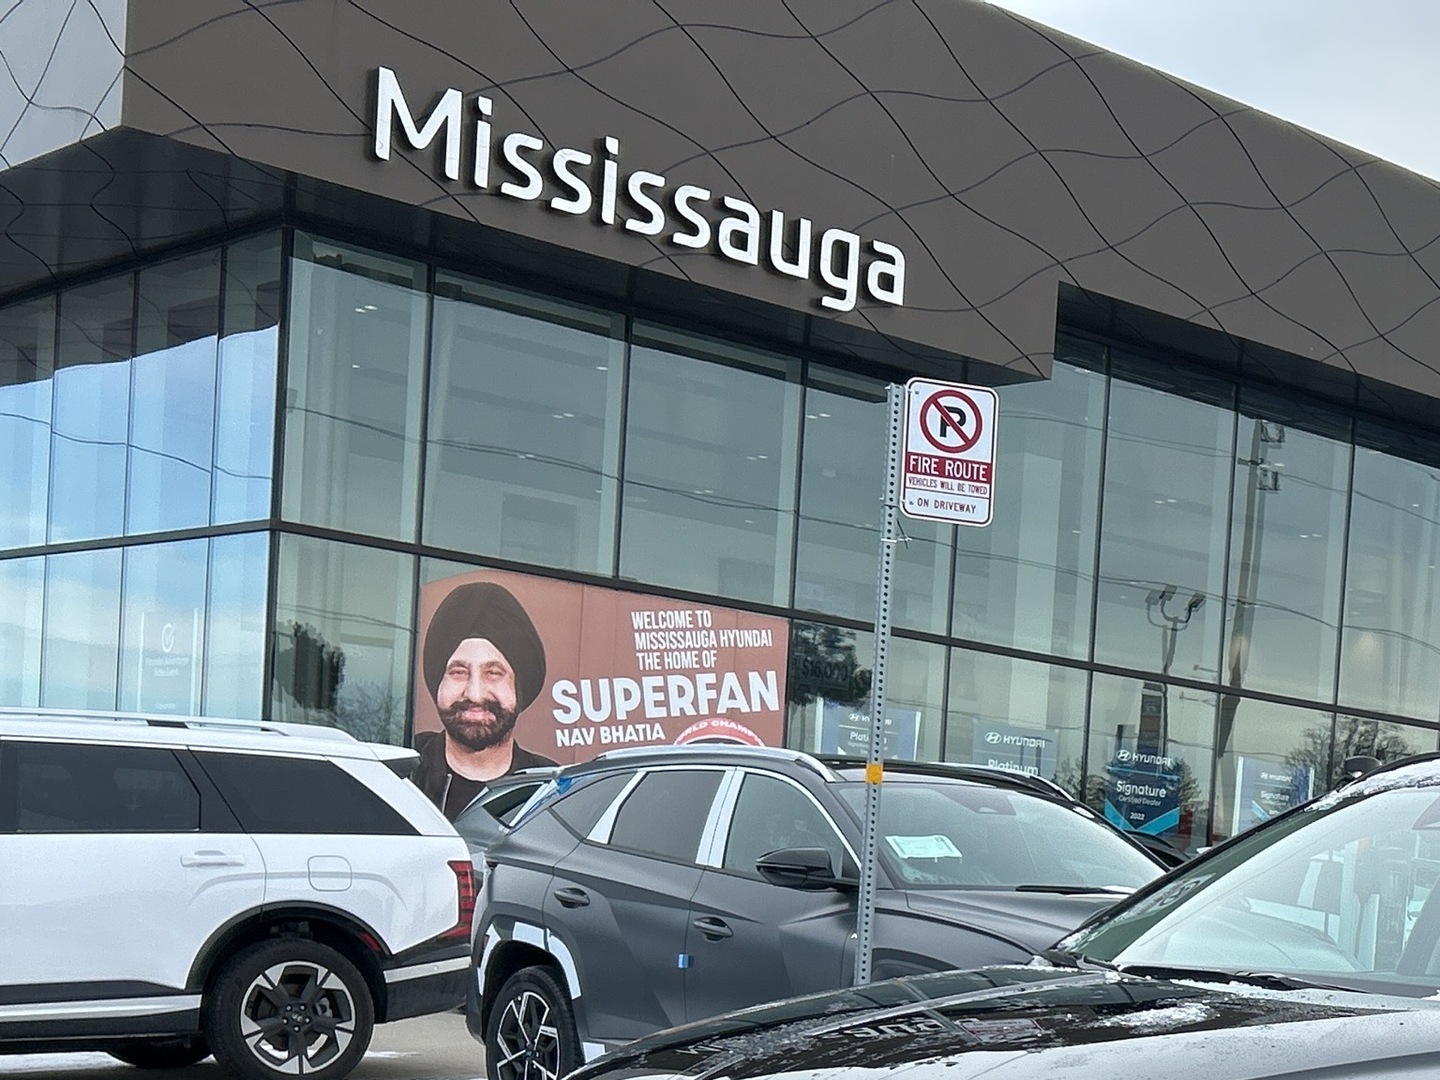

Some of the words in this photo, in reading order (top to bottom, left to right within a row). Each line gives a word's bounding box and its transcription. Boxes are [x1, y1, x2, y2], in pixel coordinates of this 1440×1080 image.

[373, 66, 906, 312] Mississauga
[909, 455, 939, 475] FIRE
[945, 460, 988, 481] ROUTE
[908, 476, 938, 488] VEHICLES
[940, 481, 955, 491] WILL
[957, 483, 965, 492] BE
[968, 484, 988, 495] TOWED
[917, 497, 929, 507] ON
[934, 500, 976, 514] DRIVEWAY
[631, 610, 694, 629] WELCOME
[695, 610, 712, 628] TO
[634, 630, 718, 650] MISSISSAUGA
[719, 629, 773, 648] HYUNDAI
[636, 652, 662, 671] THE
[664, 650, 700, 670] HOME
[702, 650, 717, 668] OF
[552, 670, 780, 725] SUPERFAN
[555, 727, 595, 748] NAV
[600, 722, 666, 744] BHATIA
[1003, 734, 1046, 748] HYUNDAI
[988, 759, 1039, 776] Platinum
[1132, 752, 1171, 766] HYUNDAI
[1116, 780, 1166, 798] Signature
